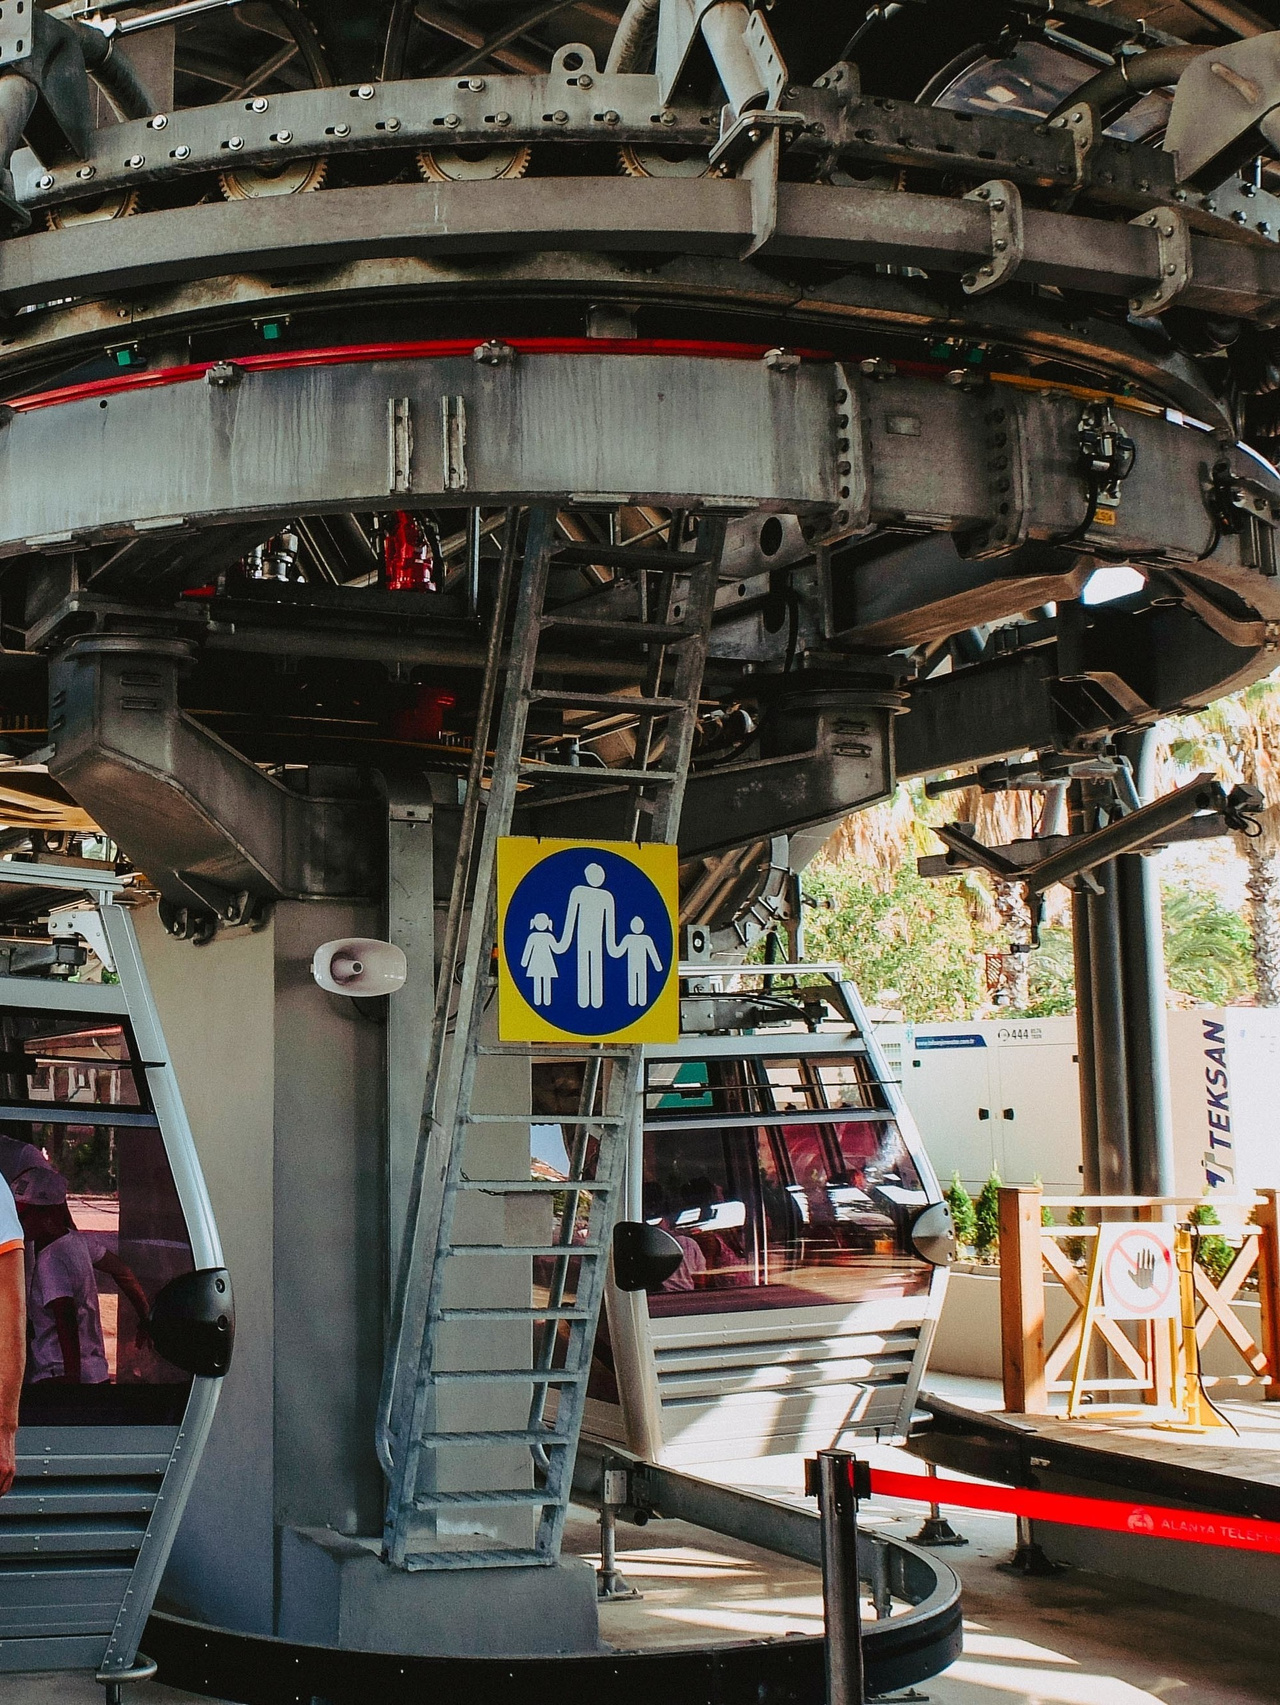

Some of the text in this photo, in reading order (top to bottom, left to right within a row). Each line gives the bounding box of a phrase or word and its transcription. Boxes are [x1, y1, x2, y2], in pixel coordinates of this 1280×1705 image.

[1010, 1029, 1028, 1040] 444
[1202, 1019, 1232, 1150] TEKSAN
[1161, 1519, 1215, 1535] ALANYA
